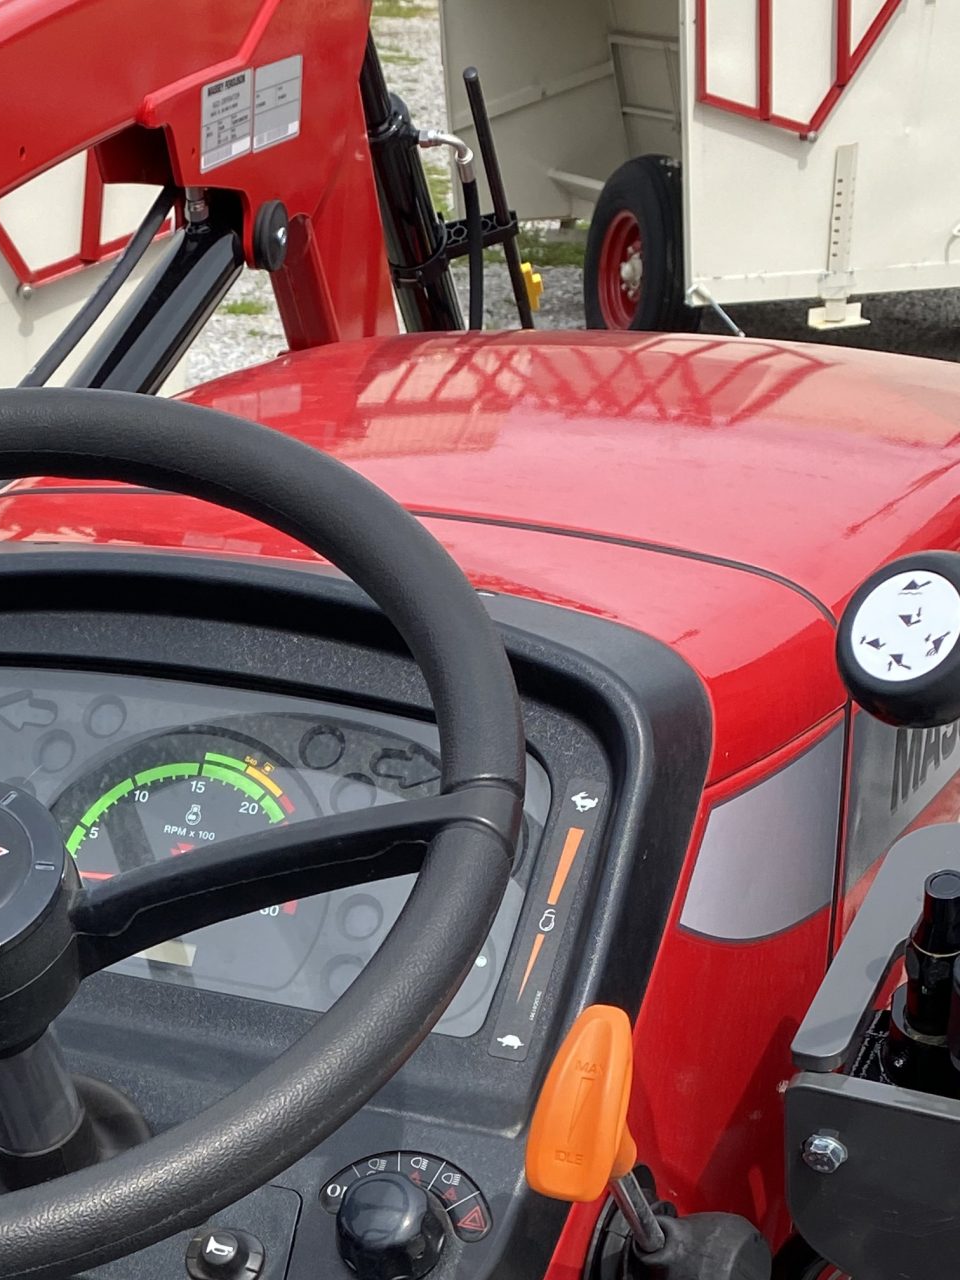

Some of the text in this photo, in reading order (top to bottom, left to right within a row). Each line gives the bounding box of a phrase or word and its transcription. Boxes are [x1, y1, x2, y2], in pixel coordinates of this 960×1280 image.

[190, 780, 206, 793] 15
[133, 789, 149, 803] 10
[238, 801, 259, 815] 20
[88, 827, 100, 839] 5
[163, 824, 215, 841] RPM x 100
[554, 1149, 584, 1166] IDLE
